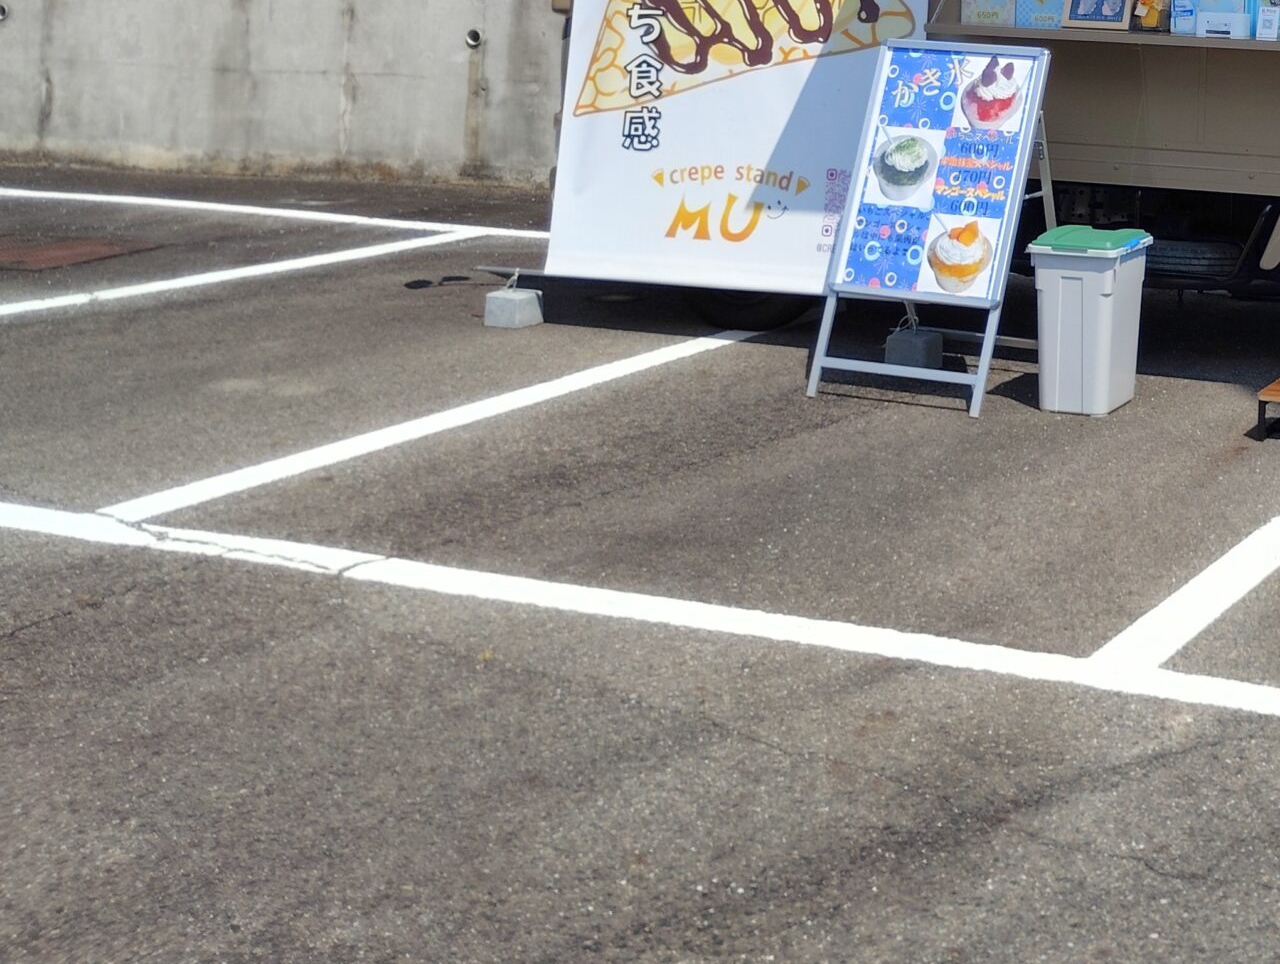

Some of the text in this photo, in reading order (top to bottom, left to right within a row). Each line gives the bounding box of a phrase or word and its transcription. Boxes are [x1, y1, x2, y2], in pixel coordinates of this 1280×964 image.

[891, 59, 974, 107] かき氷
[961, 142, 999, 158] 600円
[670, 164, 794, 192] crepe stand
[664, 192, 765, 243] MU
[950, 200, 989, 216] 600円
